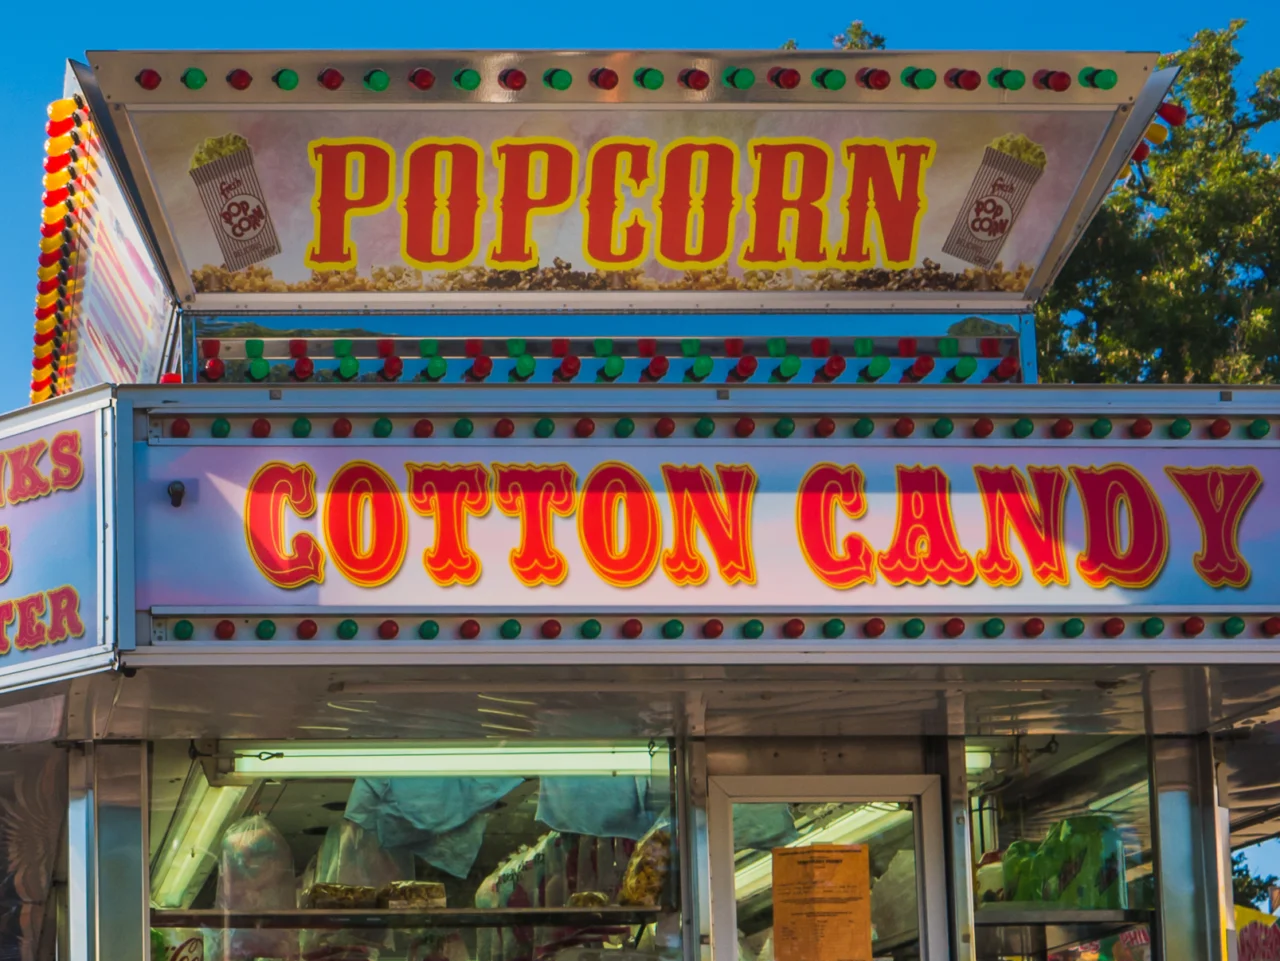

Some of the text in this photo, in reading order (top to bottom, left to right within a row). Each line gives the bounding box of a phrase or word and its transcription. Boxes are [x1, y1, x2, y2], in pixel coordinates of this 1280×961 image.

[307, 135, 935, 272] POPCORN
[242, 459, 1264, 590] COTTON CANDY
